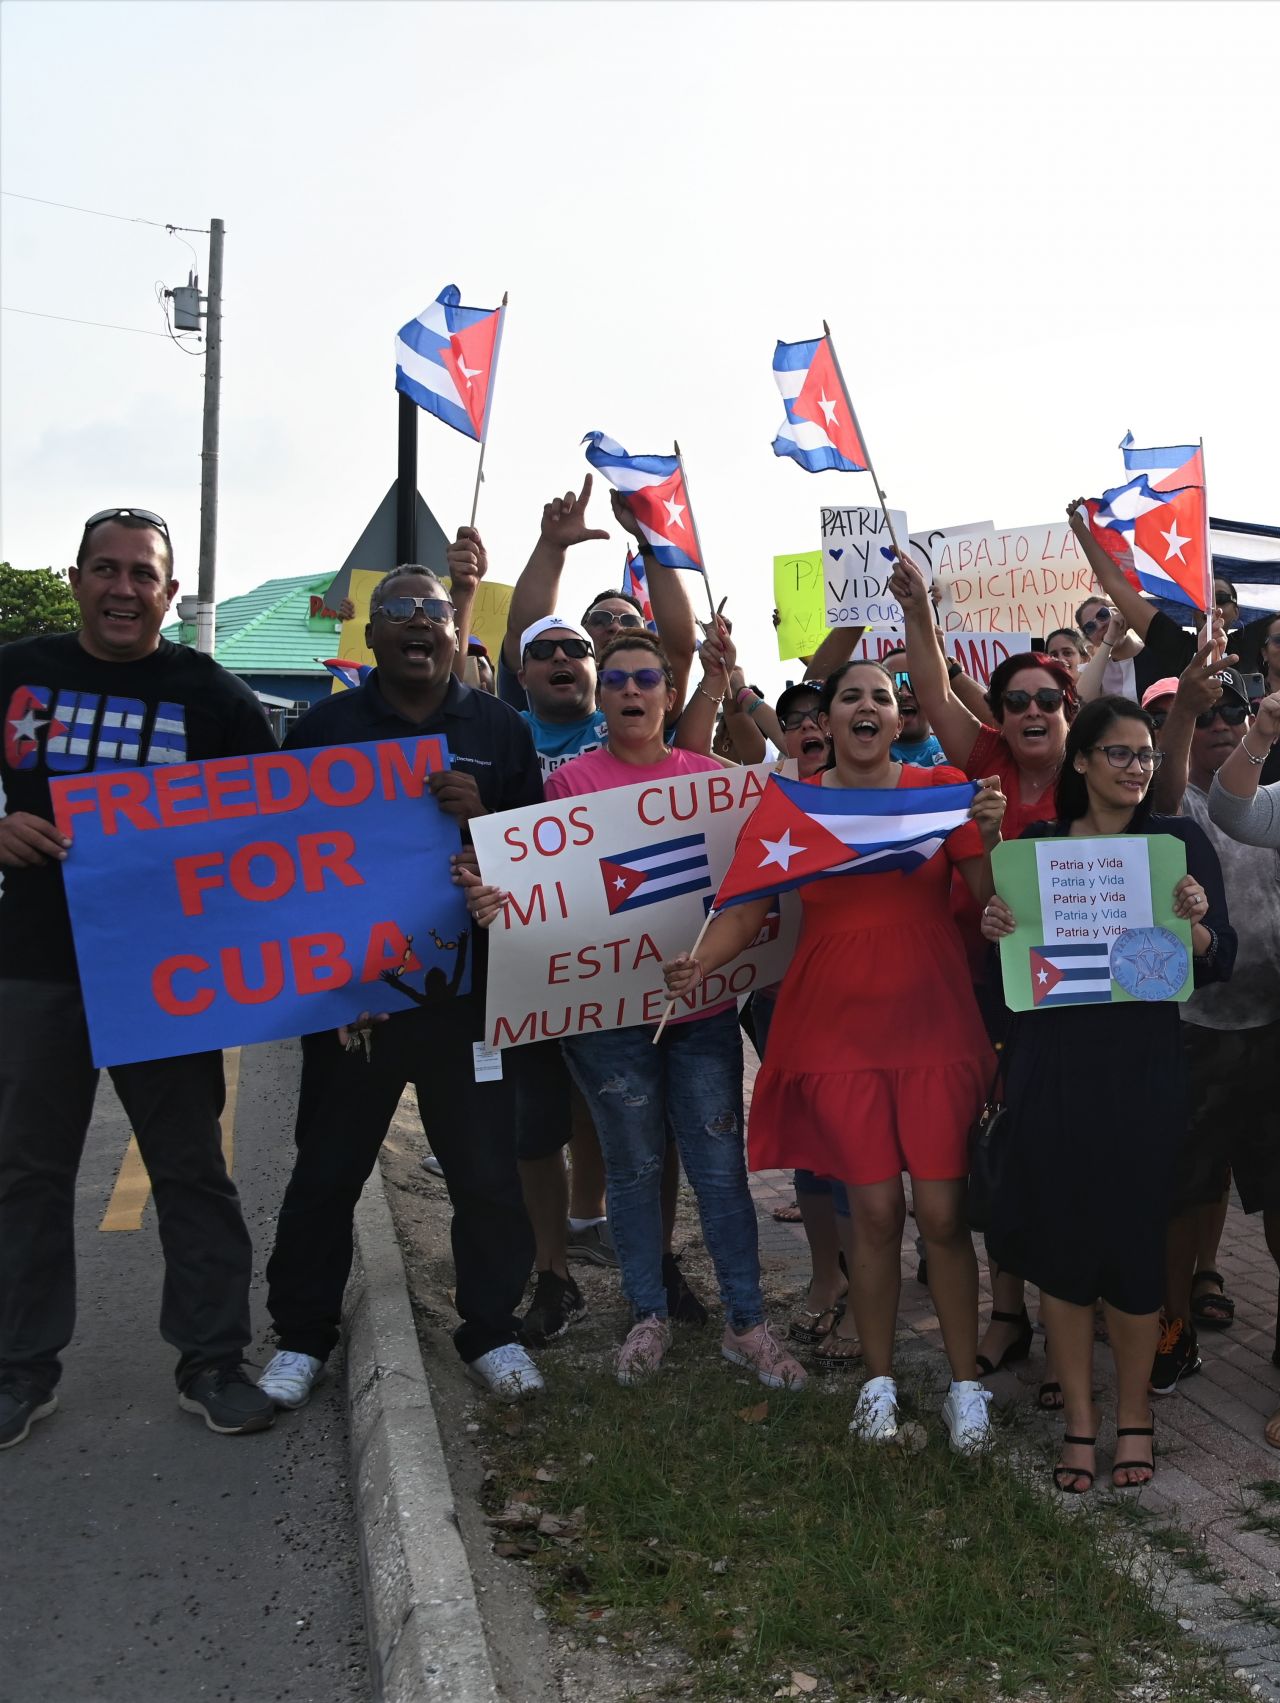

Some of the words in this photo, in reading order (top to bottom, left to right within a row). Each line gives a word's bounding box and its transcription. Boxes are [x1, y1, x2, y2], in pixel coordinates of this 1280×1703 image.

[820, 507, 895, 537] PATRIA
[852, 540, 870, 573] Y
[939, 535, 1029, 575] ABAJO
[1041, 529, 1080, 561] LA
[827, 606, 860, 623] SOS
[866, 603, 905, 624] CUB
[945, 602, 1033, 633] PATRIA
[3, 683, 188, 773] CUBA
[49, 737, 445, 842] FREEDOM
[503, 805, 595, 863] SOS
[636, 769, 767, 827] CUBA
[173, 830, 366, 917] FOR
[1050, 859, 1084, 871] Patria
[1087, 861, 1094, 872] y
[1097, 857, 1123, 869] Vida
[1052, 876, 1086, 888] Patria
[1088, 878, 1096, 889] y
[1098, 874, 1125, 886] Vida
[501, 880, 569, 931] MI
[1053, 892, 1087, 904] Patria
[1089, 895, 1097, 906] y
[1100, 891, 1126, 902] Vida
[1055, 909, 1088, 921] Patria
[1091, 912, 1098, 922] y
[1101, 908, 1127, 919] Vida
[1056, 926, 1089, 938] Patria
[1092, 928, 1099, 939] y
[1102, 925, 1128, 936] Vida
[150, 919, 425, 1017] CUBA
[547, 932, 664, 986] ESTA
[492, 962, 757, 1047] MURIENDO
